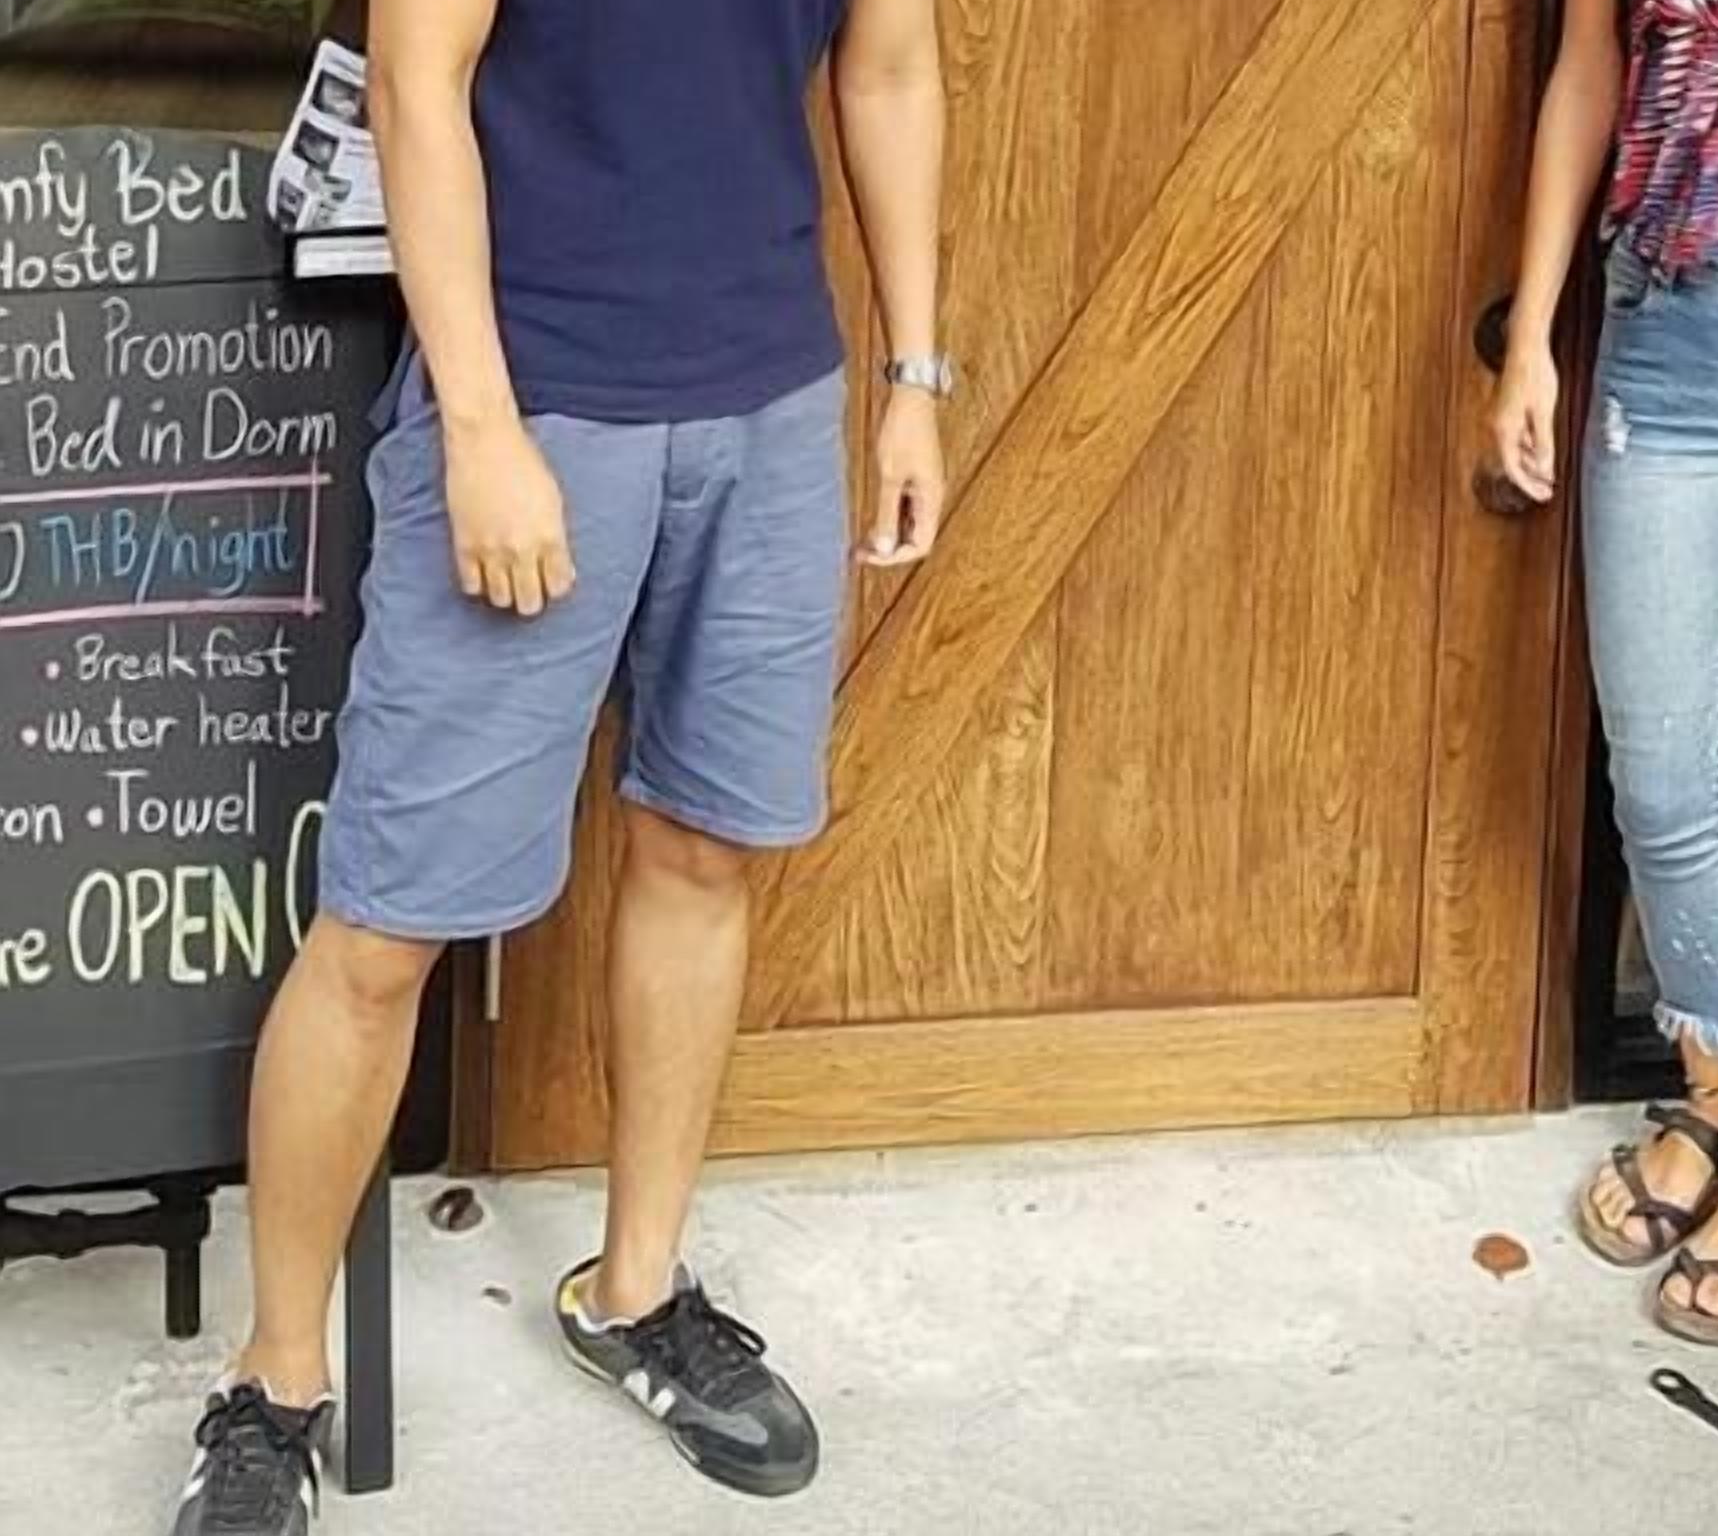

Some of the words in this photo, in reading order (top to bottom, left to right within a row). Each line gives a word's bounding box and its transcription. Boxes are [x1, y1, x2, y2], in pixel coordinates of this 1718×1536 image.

[106, 132, 248, 226] Bed
[102, 296, 333, 381] Promotion
[27, 393, 122, 477] Bed
[139, 398, 183, 466] in
[203, 387, 337, 461] Dorm
[45, 697, 178, 752] Water
[200, 684, 333, 746] heater
[0, 803, 63, 843] on
[105, 762, 257, 835] Towel
[68, 859, 266, 984] OPEN
